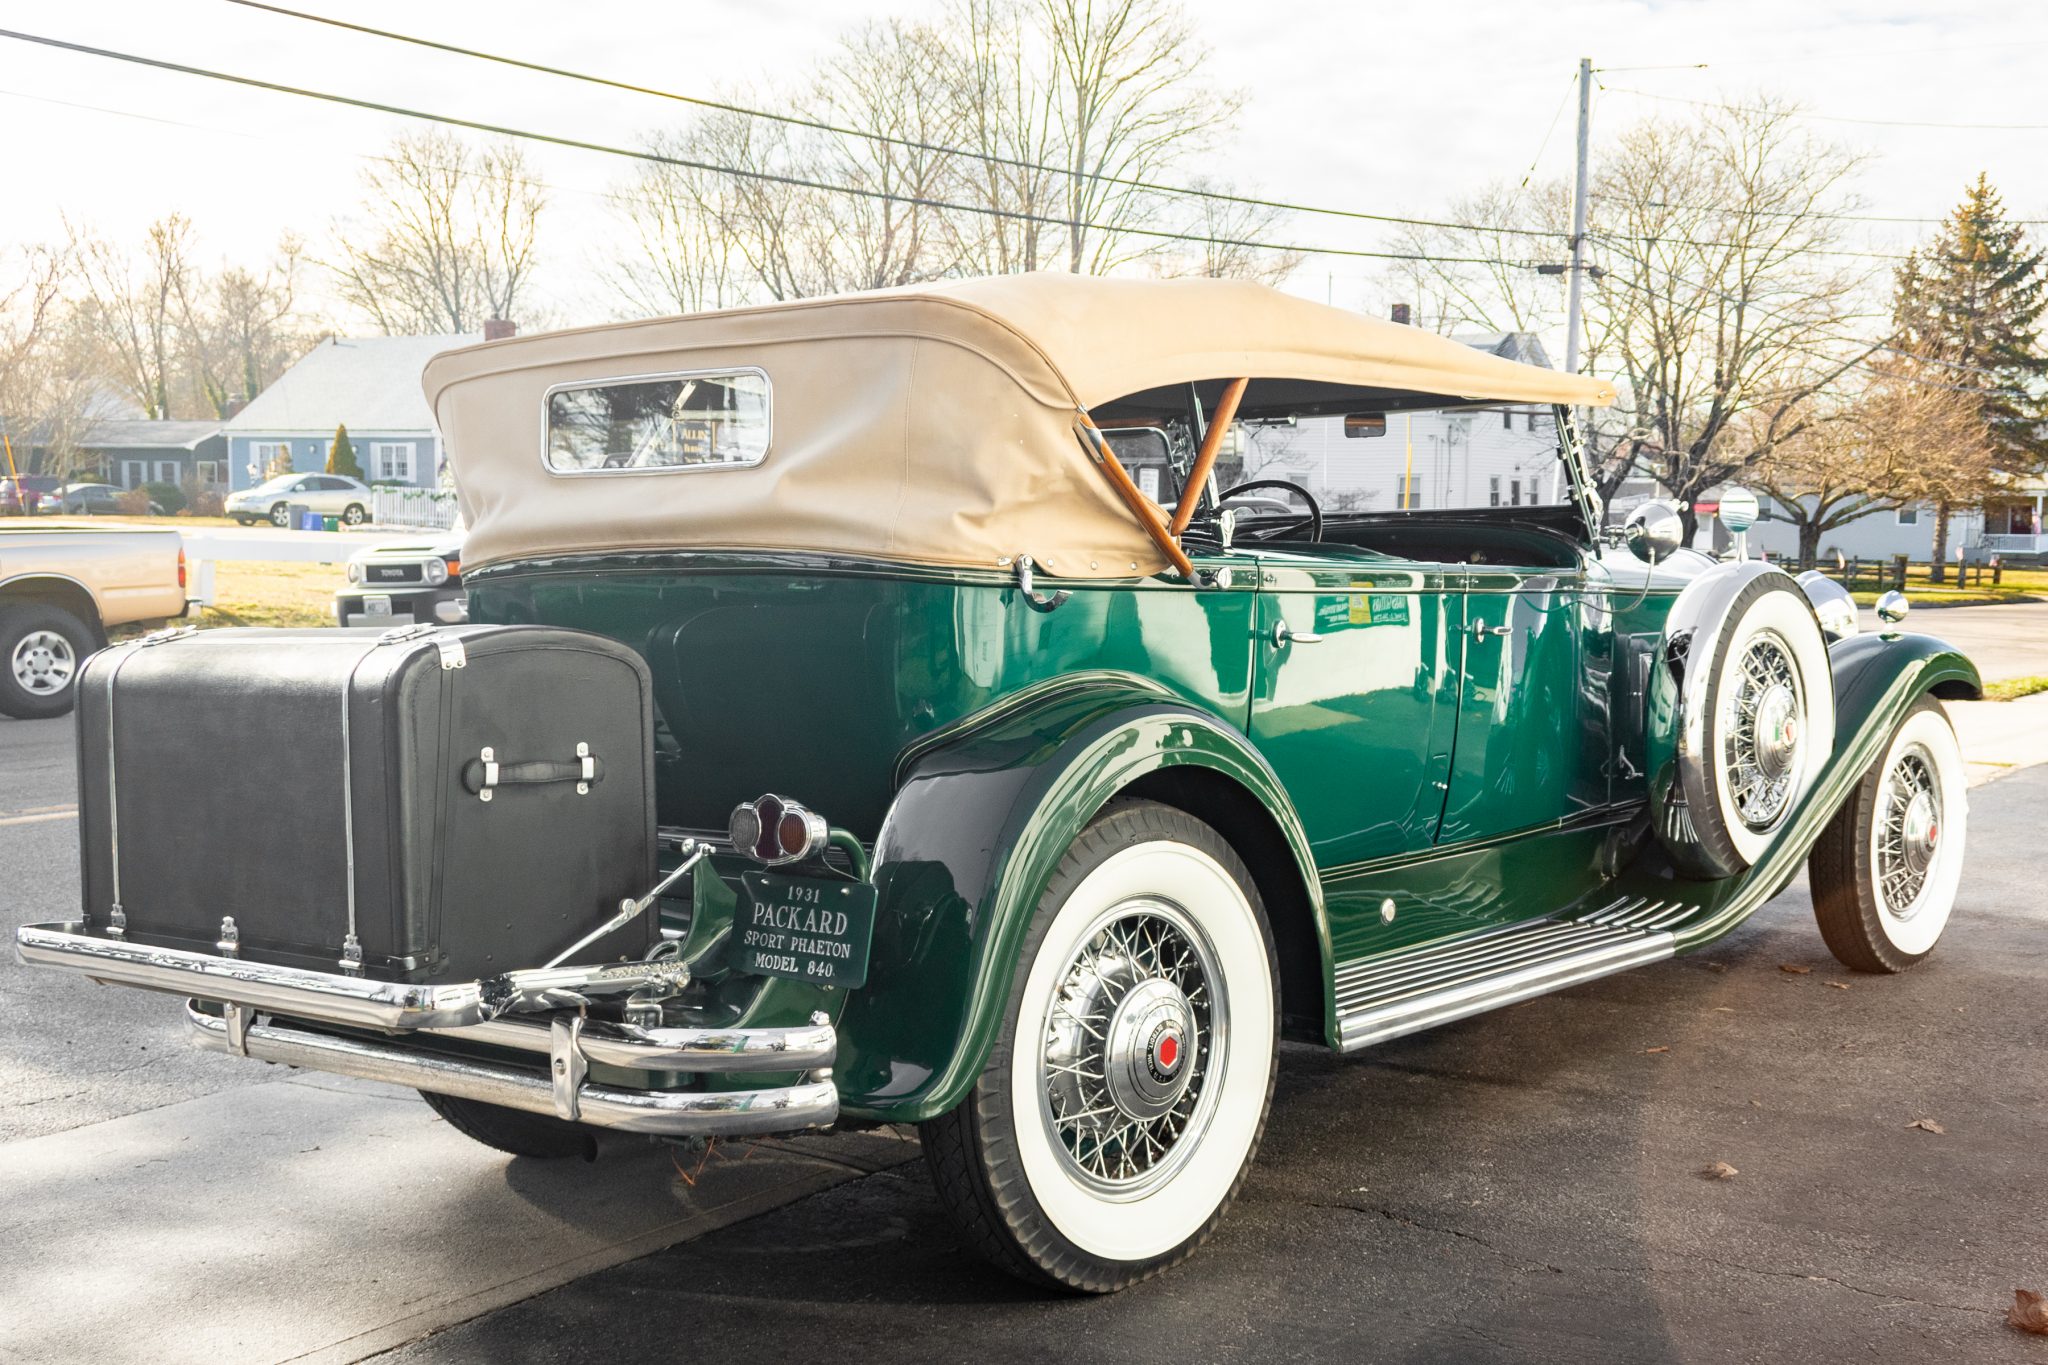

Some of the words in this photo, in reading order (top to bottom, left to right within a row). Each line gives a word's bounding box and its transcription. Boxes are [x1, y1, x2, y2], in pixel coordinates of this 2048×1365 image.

[381, 569, 404, 577] TOYOTA
[787, 885, 820, 903] 1931
[752, 902, 848, 936] PACKARD
[744, 930, 784, 949] SPORT
[790, 937, 851, 959] PHAETON
[755, 952, 799, 973] MODEL
